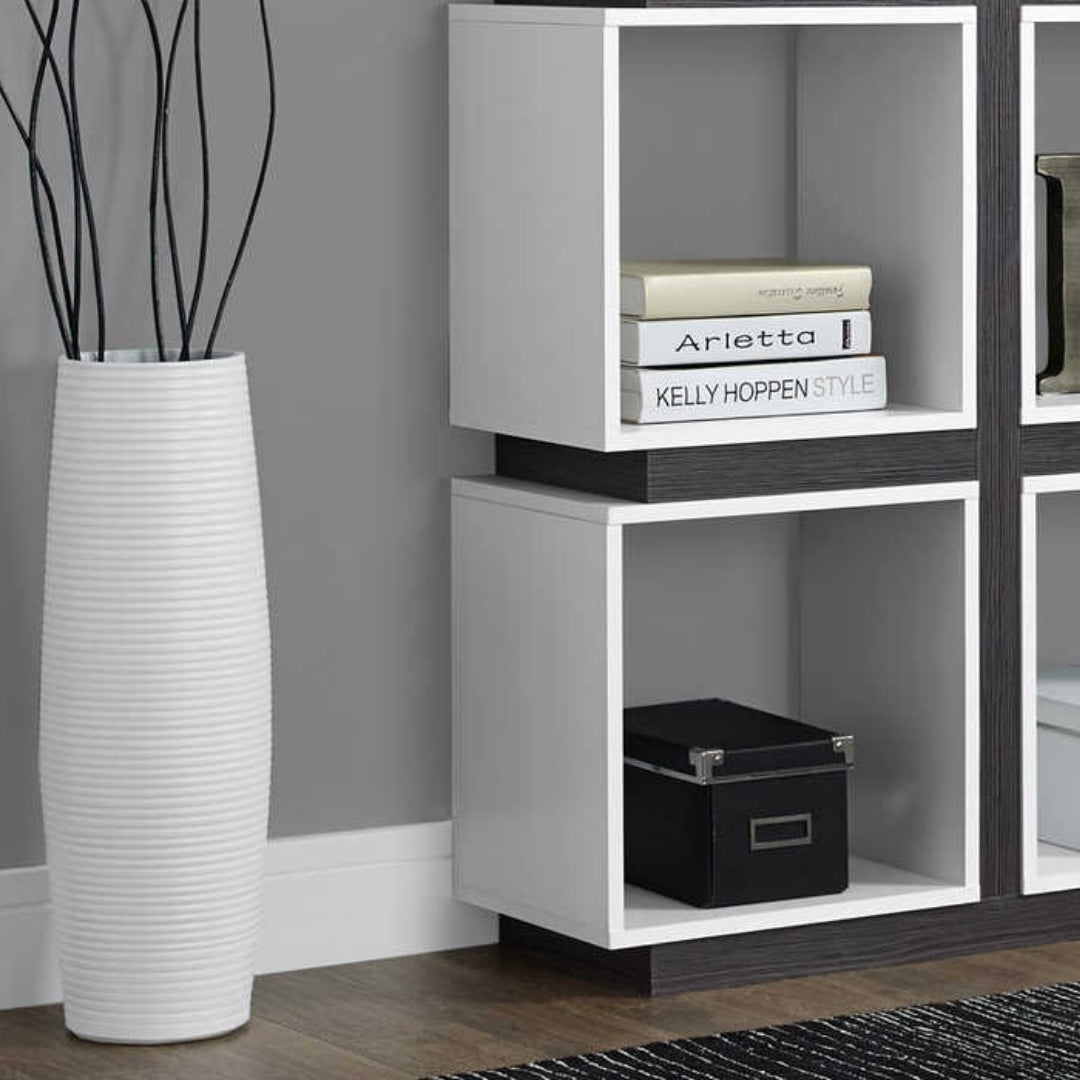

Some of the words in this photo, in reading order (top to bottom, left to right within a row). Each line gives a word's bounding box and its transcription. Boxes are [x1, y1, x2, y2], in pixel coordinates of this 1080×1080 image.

[675, 329, 816, 352] Arletta
[655, 383, 720, 408] KELLY
[723, 377, 809, 404] HOPPEN
[812, 373, 876, 398] STYLE
